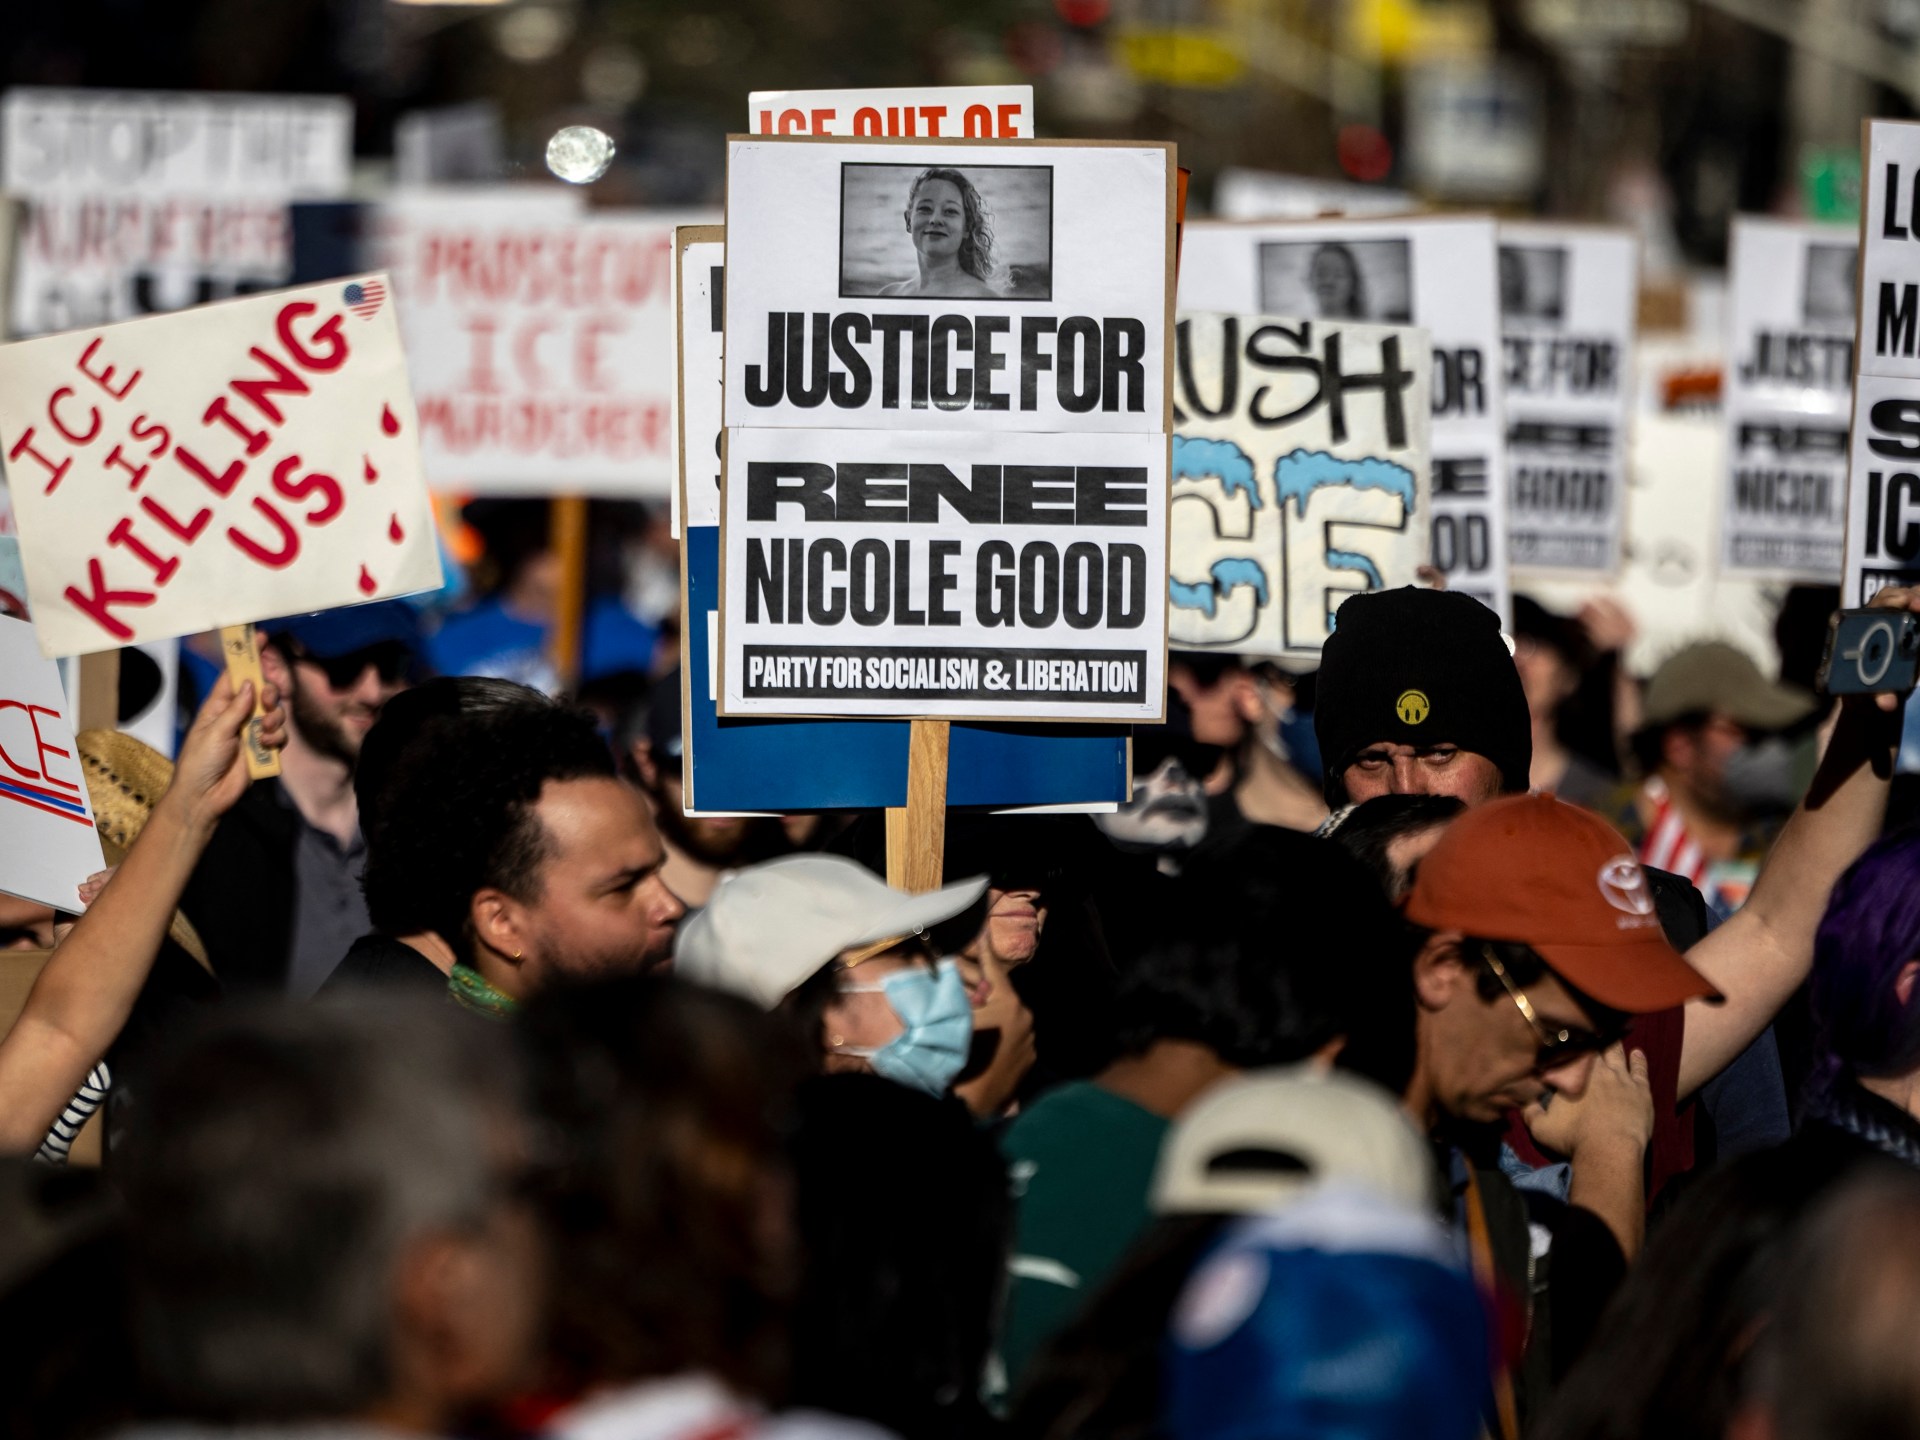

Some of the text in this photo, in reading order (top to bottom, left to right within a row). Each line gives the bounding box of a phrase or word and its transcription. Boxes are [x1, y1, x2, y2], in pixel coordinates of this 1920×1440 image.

[458, 315, 628, 394] ICE
[745, 312, 1010, 411] JUSTICE
[1020, 316, 1145, 413] FOR
[9, 337, 143, 496] ICE
[104, 414, 171, 490] IS
[65, 302, 349, 641] KILLING
[227, 455, 345, 569] US
[747, 462, 1147, 526] RENEE
[746, 538, 1146, 629] NICOLE GOOD
[749, 656, 1137, 693] PARTY FOR SOCIALISM & LIBERATION
